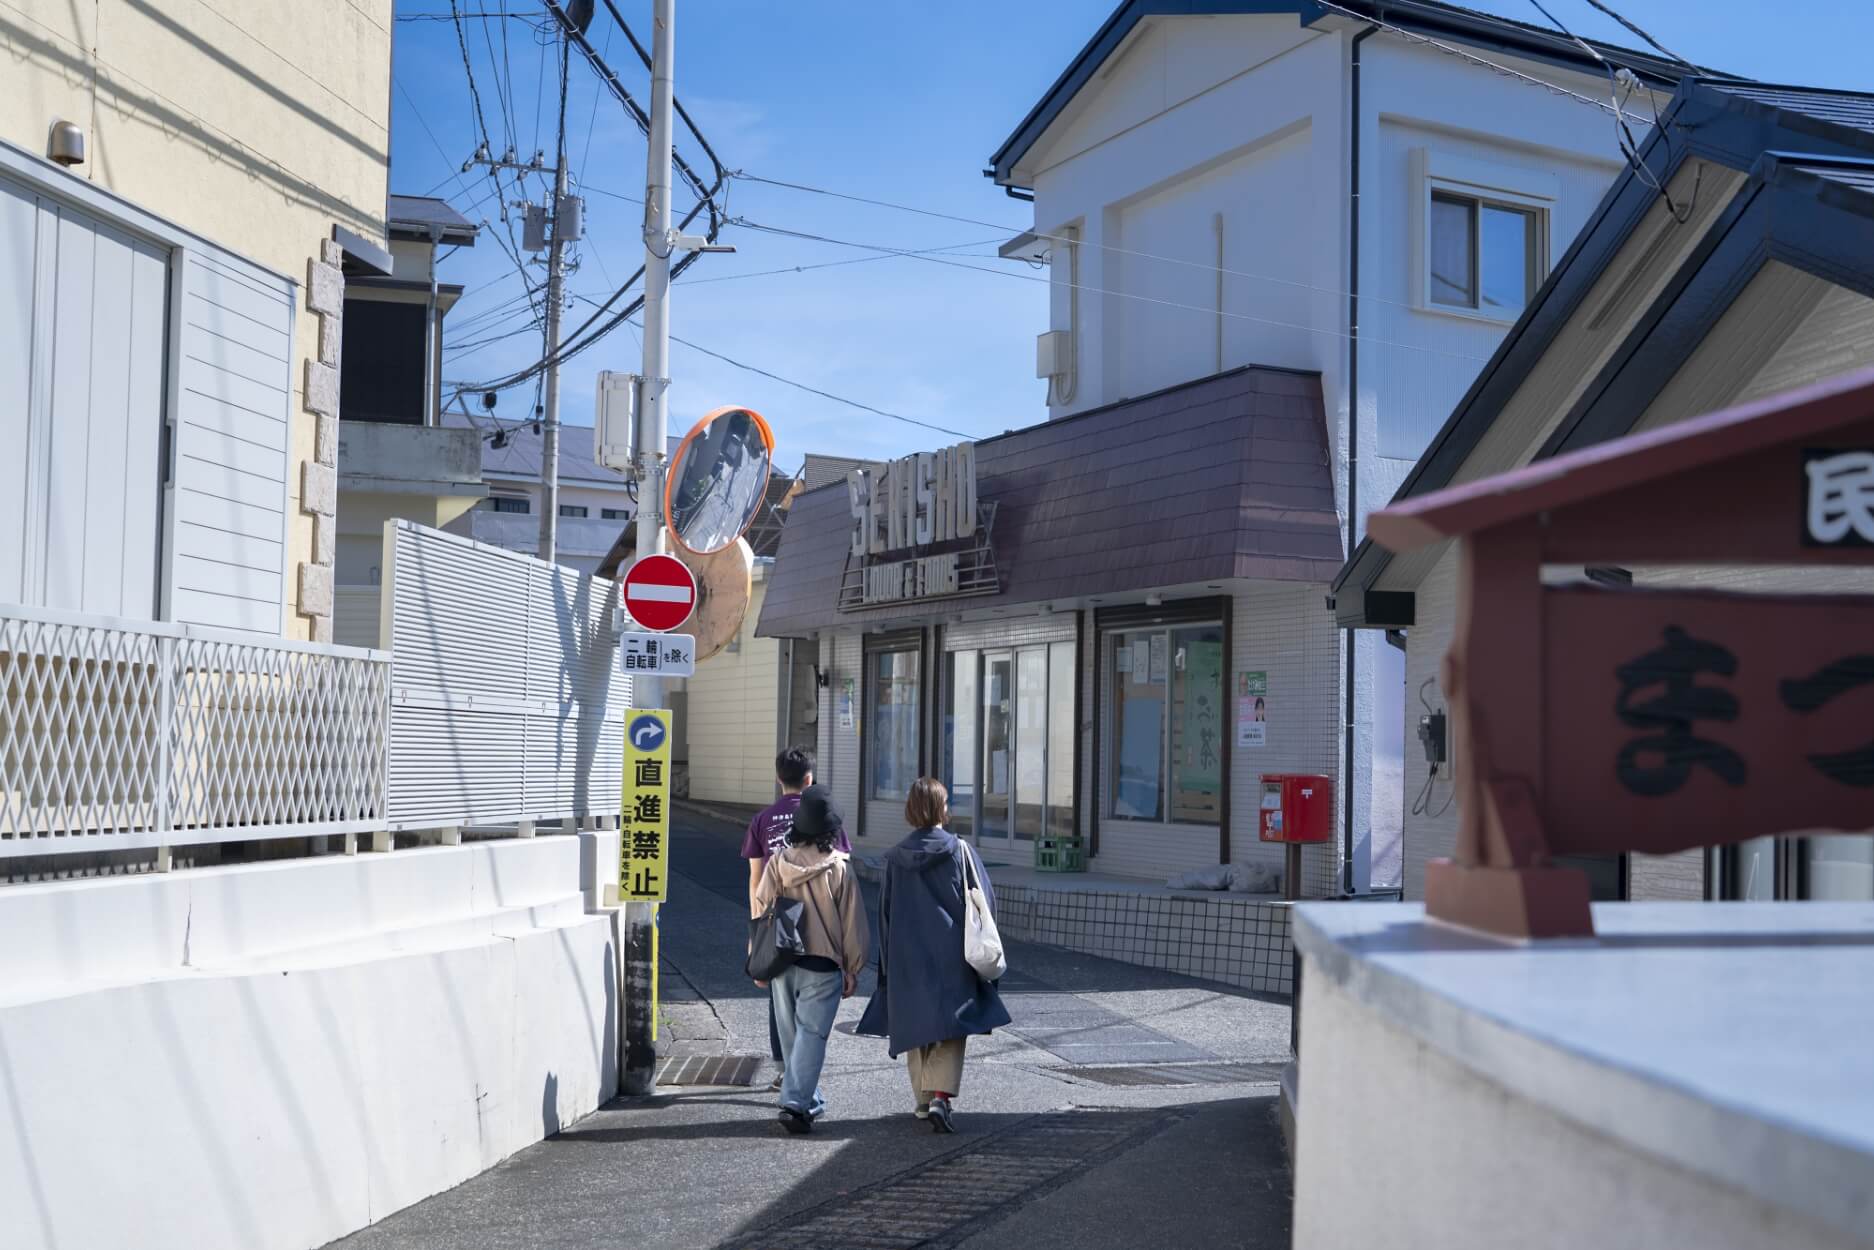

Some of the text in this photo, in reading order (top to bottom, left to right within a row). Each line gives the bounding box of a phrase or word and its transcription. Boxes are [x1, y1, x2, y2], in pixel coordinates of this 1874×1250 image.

[1804, 452, 1874, 542] 民
[626, 655, 657, 669] 自転車
[664, 648, 689, 663] を除く
[630, 757, 664, 897] 直進禁止
